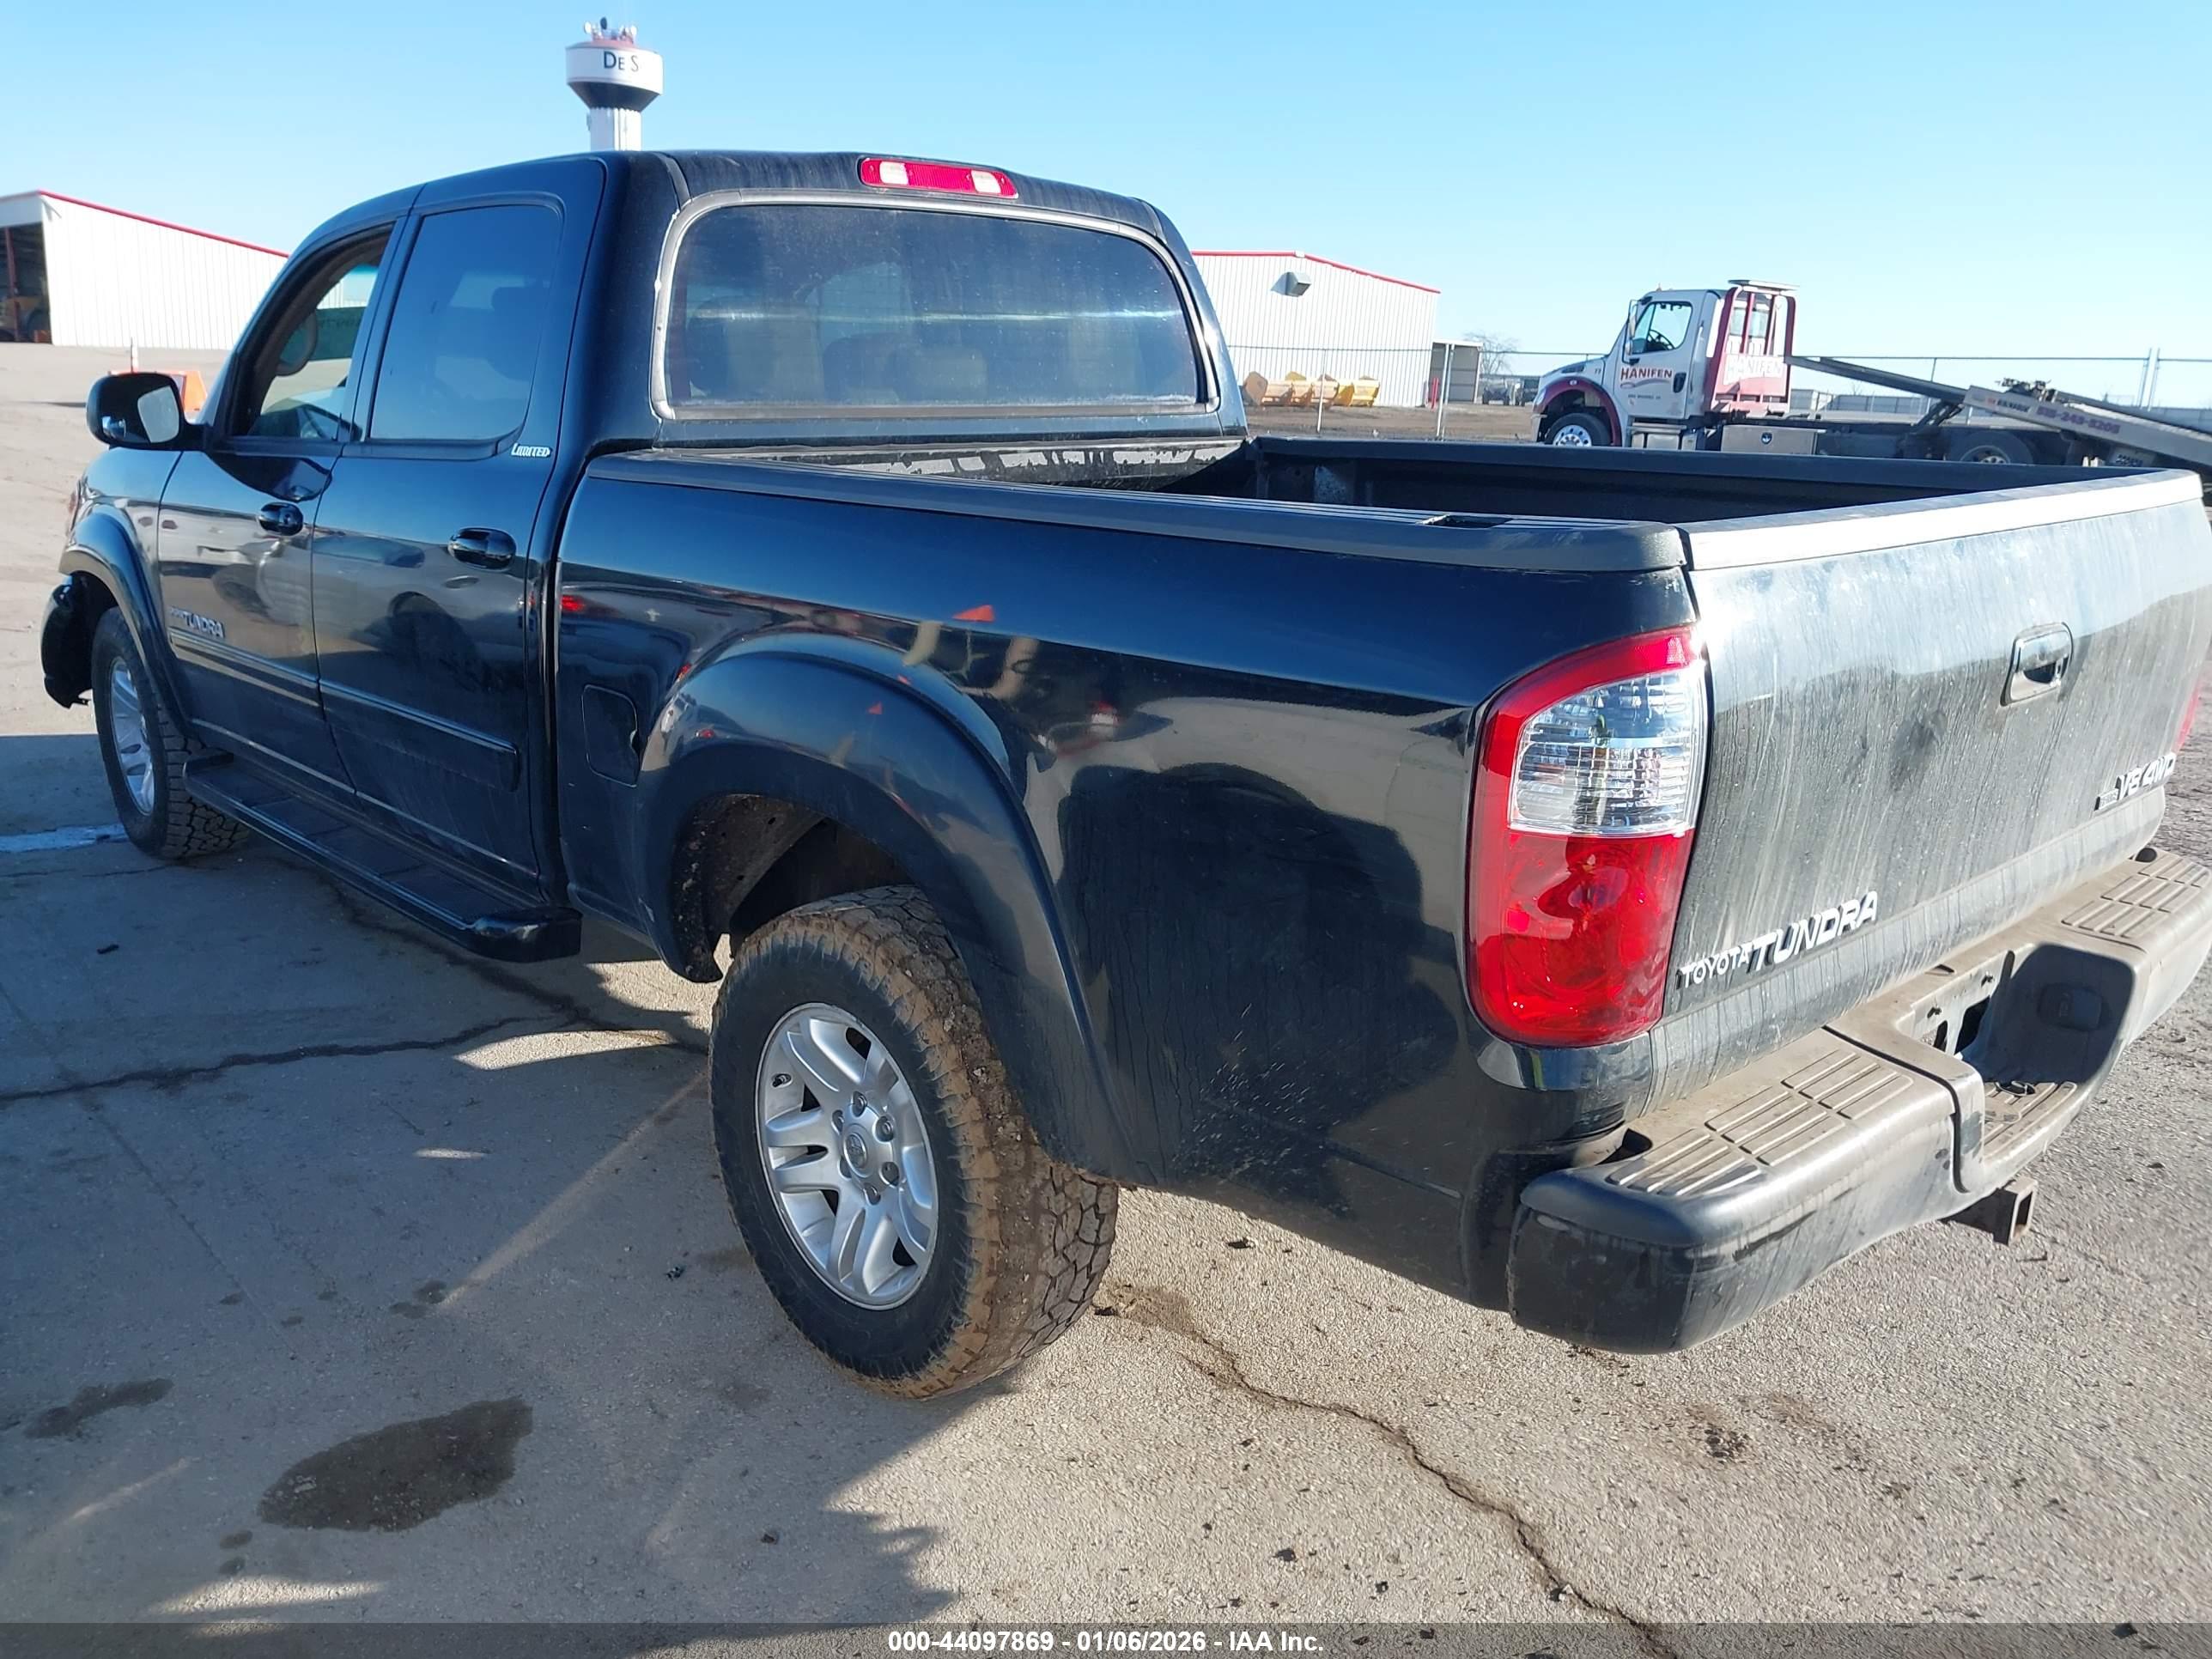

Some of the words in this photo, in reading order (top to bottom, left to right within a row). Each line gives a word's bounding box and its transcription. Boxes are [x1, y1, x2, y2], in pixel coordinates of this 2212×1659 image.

[1620, 368, 1673, 381] HANIFEN
[511, 442, 551, 458] LIMITED
[182, 610, 224, 638] TUNDRA
[1679, 944, 1749, 988] TOYOTA
[1749, 890, 1878, 972] TUNDRA
